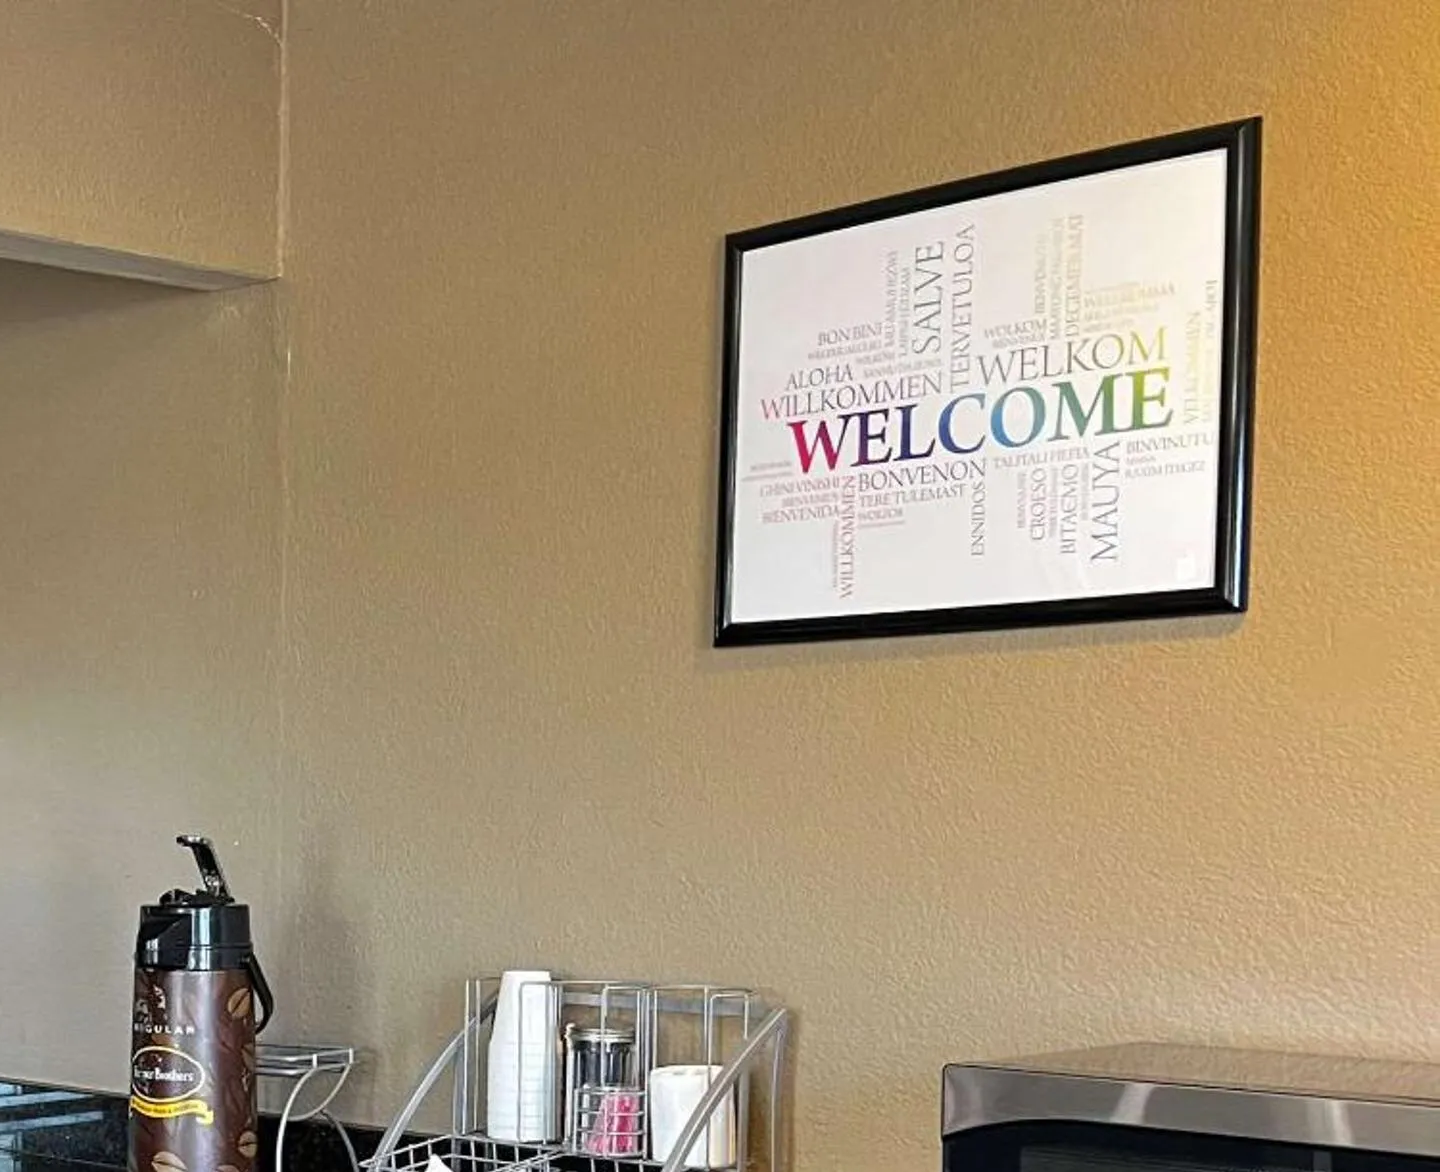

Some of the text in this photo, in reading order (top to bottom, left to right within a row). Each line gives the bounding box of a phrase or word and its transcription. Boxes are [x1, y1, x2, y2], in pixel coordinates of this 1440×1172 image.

[912, 241, 945, 354] SALVE
[950, 224, 977, 393] TERVETULOA
[761, 371, 942, 420] WILLKOMMEN
[785, 363, 854, 392] ALOHA
[977, 327, 1166, 386] WELKOM
[788, 366, 1174, 474] WELCOME
[858, 456, 987, 493] BONVENON
[1029, 467, 1047, 541] CROESO
[1090, 441, 1121, 562] MAUYA
[839, 474, 856, 600] WILLKOMMEN
